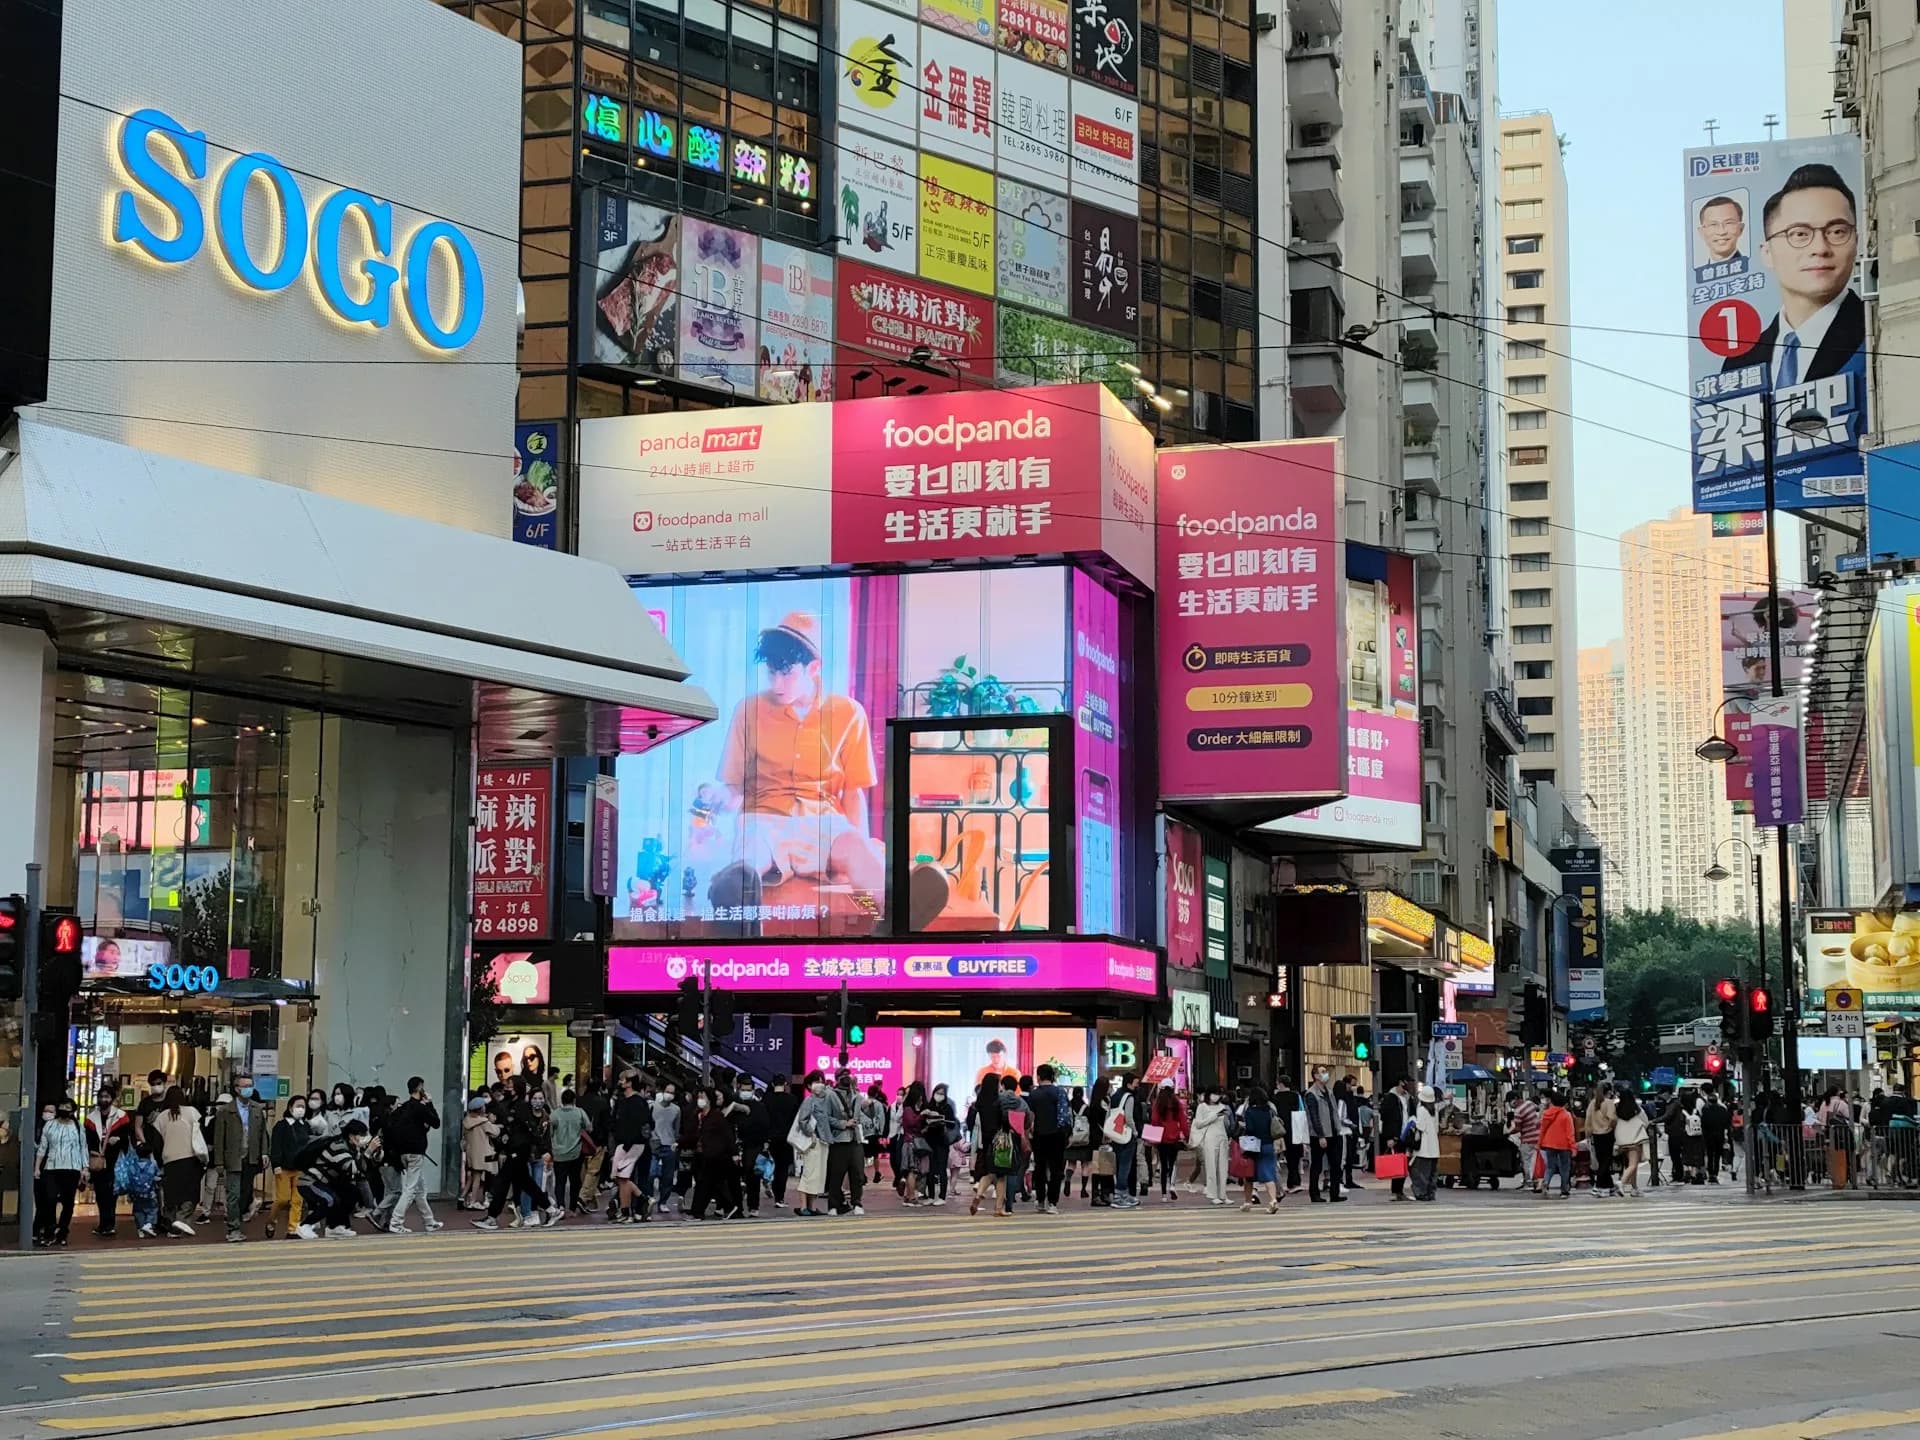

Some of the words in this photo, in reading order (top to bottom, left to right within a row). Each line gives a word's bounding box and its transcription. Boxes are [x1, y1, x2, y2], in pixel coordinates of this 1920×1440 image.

[1001, 8, 1031, 31] 2881
[1035, 20, 1066, 43] 8204
[924, 59, 991, 138] 金羅寶
[1001, 88, 1066, 145] 韓國料理
[1115, 106, 1133, 123] 6/F
[1102, 131, 1130, 152] 한국요리
[1044, 149, 1065, 163] 3986
[1712, 152, 1760, 168] 民建聯
[1735, 165, 1760, 174] DAB
[112, 108, 486, 350] SOGO
[603, 230, 618, 243] 3F
[892, 222, 913, 241] 5/F
[973, 231, 991, 249] 5/F
[925, 243, 988, 272] 正宗重慶風味
[1702, 260, 1743, 281] 曾鈺成
[1694, 272, 1764, 304] 全力支持
[872, 284, 966, 331] 麻辣派對
[1126, 306, 1137, 320] 5F
[872, 315, 912, 340] CHILI
[916, 325, 965, 353] PARTY
[1718, 306, 1739, 350] 1
[640, 431, 700, 456] panda
[705, 428, 758, 450] mart
[883, 410, 1051, 451] foodpanda
[650, 459, 756, 478] 24小時網上超市
[884, 456, 1051, 497] 要乜即刻有
[1701, 481, 1728, 495] Edward
[1729, 477, 1751, 489] Leung
[1777, 465, 1807, 477] Change
[658, 511, 733, 528] foodpanda
[738, 507, 768, 522] mall
[884, 501, 1051, 543] 生活更就手
[1176, 506, 1317, 540] foodpanda
[526, 522, 550, 538] 6/F
[652, 535, 751, 552] 一站式生活平台
[1178, 547, 1317, 580] 要乜即刻有
[1178, 584, 1318, 616] 生活更就手
[1215, 648, 1291, 665] 即時生活百貨
[1197, 732, 1232, 746] Order
[1236, 730, 1301, 745] 大細無限制
[507, 772, 531, 785] 4/F
[1769, 730, 1783, 819] 香港亞洲國際都會
[497, 918, 539, 933] 4898
[1581, 886, 1598, 957] IKEA
[150, 963, 219, 992] SOGO
[691, 957, 790, 981] foodpanda
[957, 959, 1027, 973] BUYFREE
[1831, 1014, 1843, 1022] 24
[1846, 1014, 1859, 1022] hrs
[1835, 1024, 1856, 1034] 全日
[768, 1038, 783, 1051] 3F
[1105, 1039, 1136, 1068] iB
